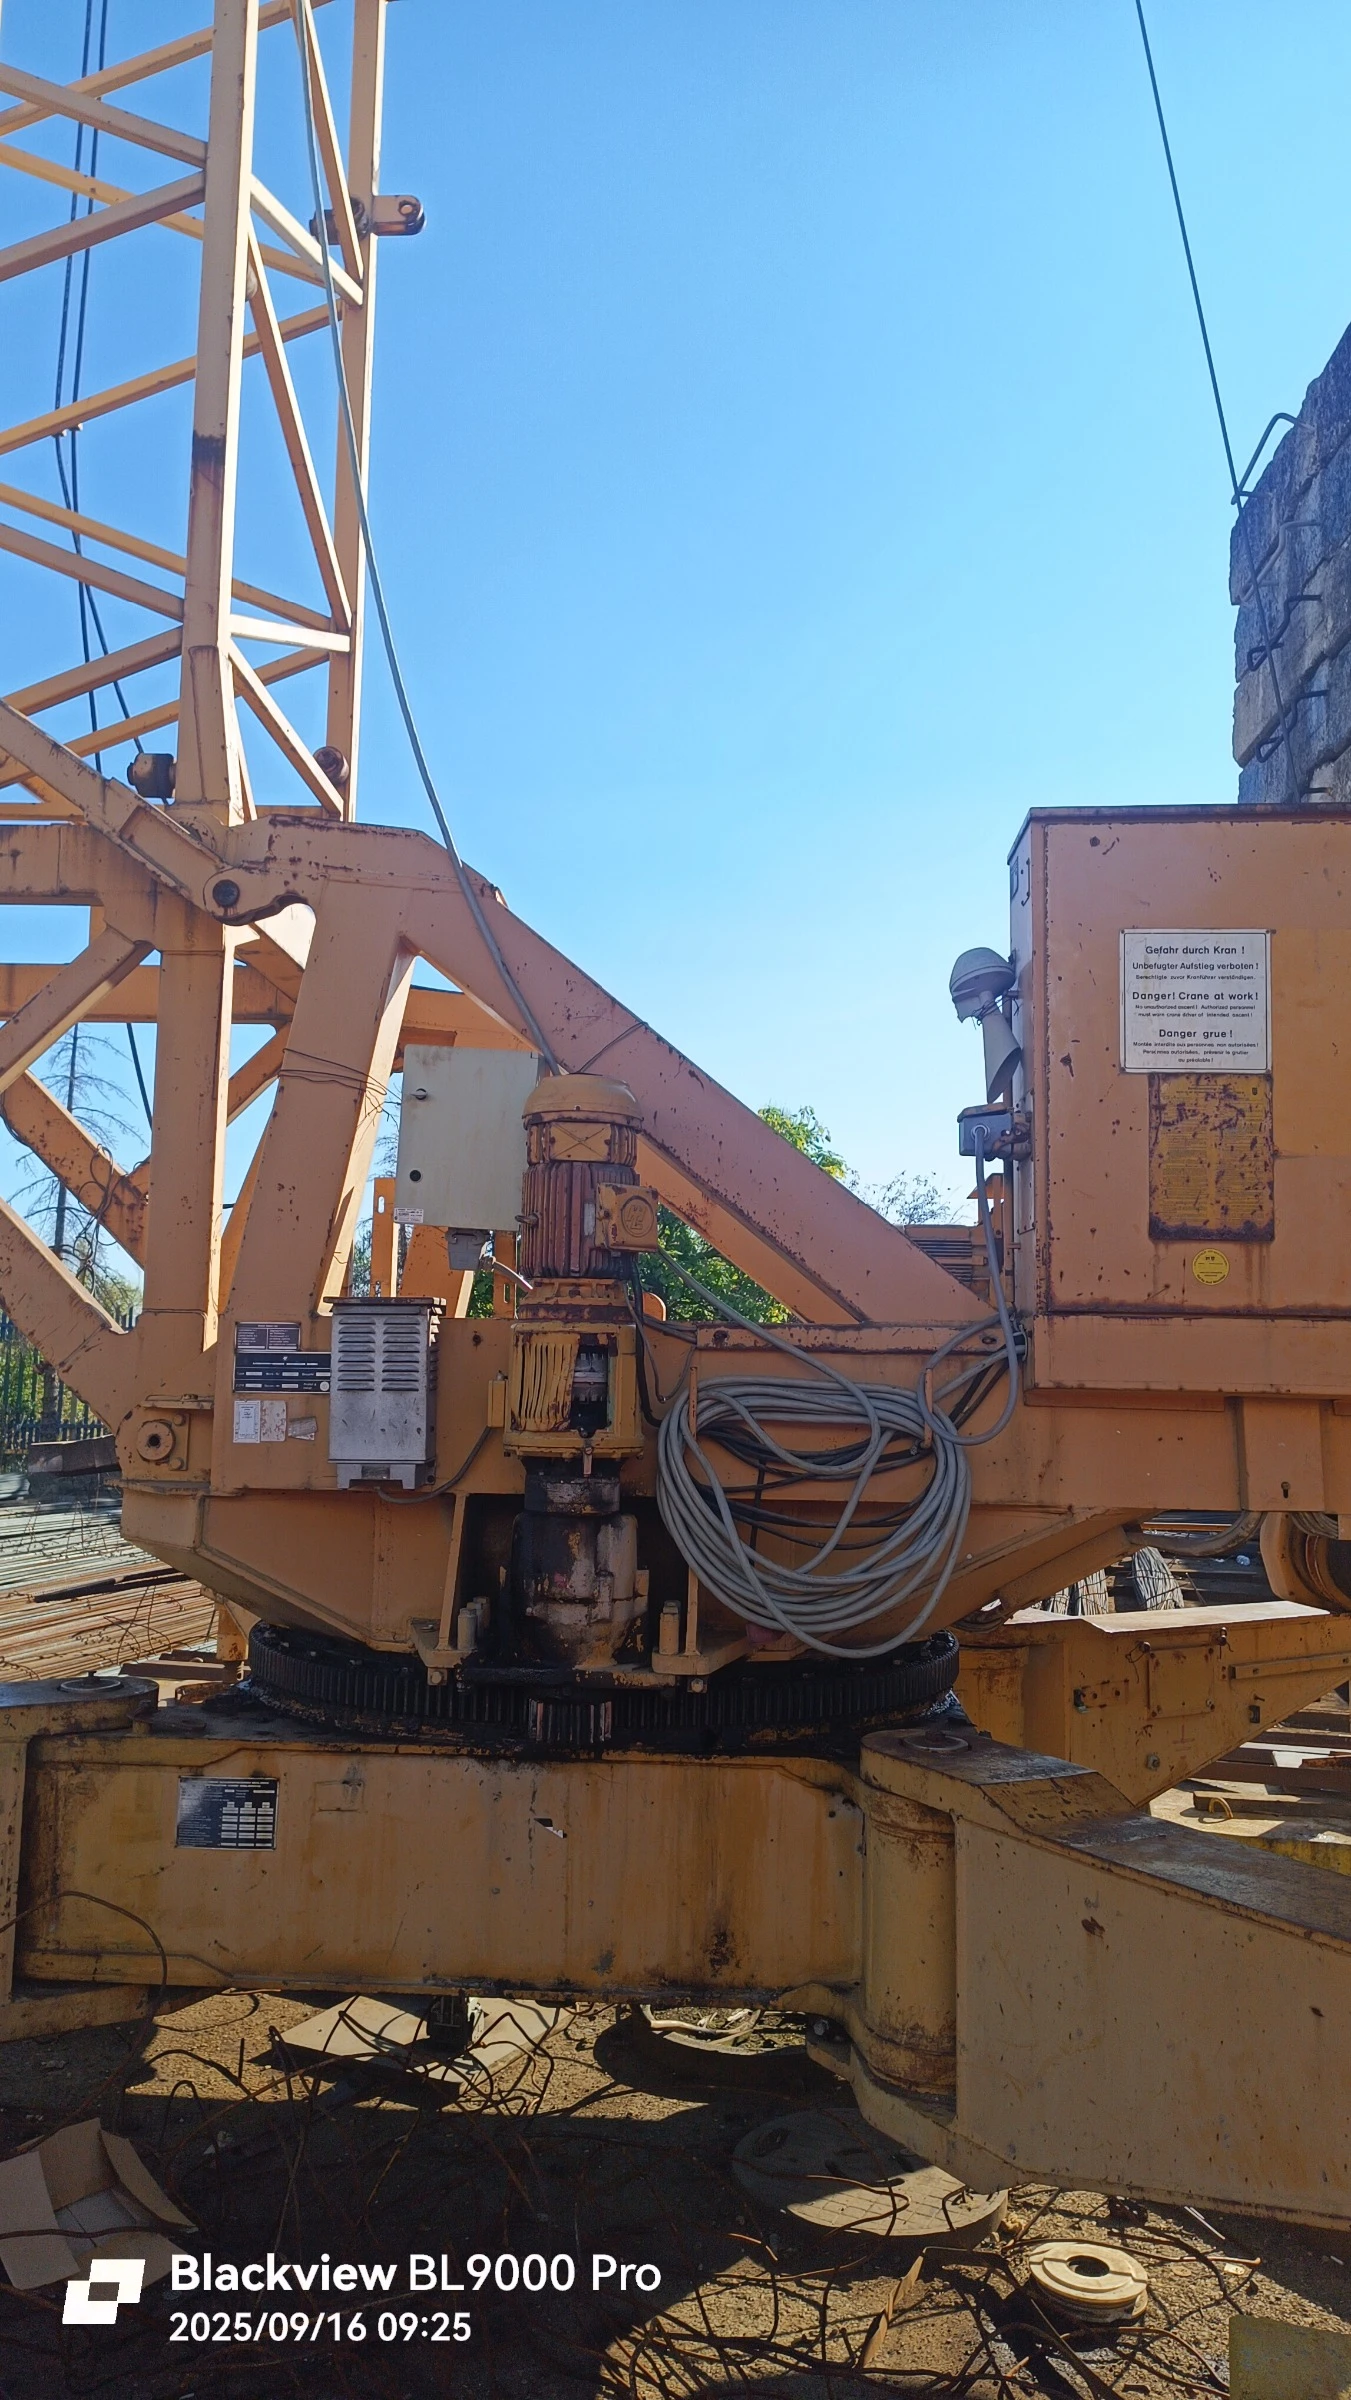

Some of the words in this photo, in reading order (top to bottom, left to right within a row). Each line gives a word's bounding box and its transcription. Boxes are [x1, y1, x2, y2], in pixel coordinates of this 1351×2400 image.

[1145, 946, 1179, 954] Gefahr
[1182, 946, 1210, 954] durch
[1213, 946, 1237, 954] Kran
[1132, 962, 1178, 970] Unbefugter
[1180, 962, 1214, 970] Aufstieg
[1132, 992, 1176, 1001] Danger!
[1178, 992, 1209, 1000] Crane
[1214, 992, 1224, 1000] at
[1160, 1029, 1196, 1039] Danger
